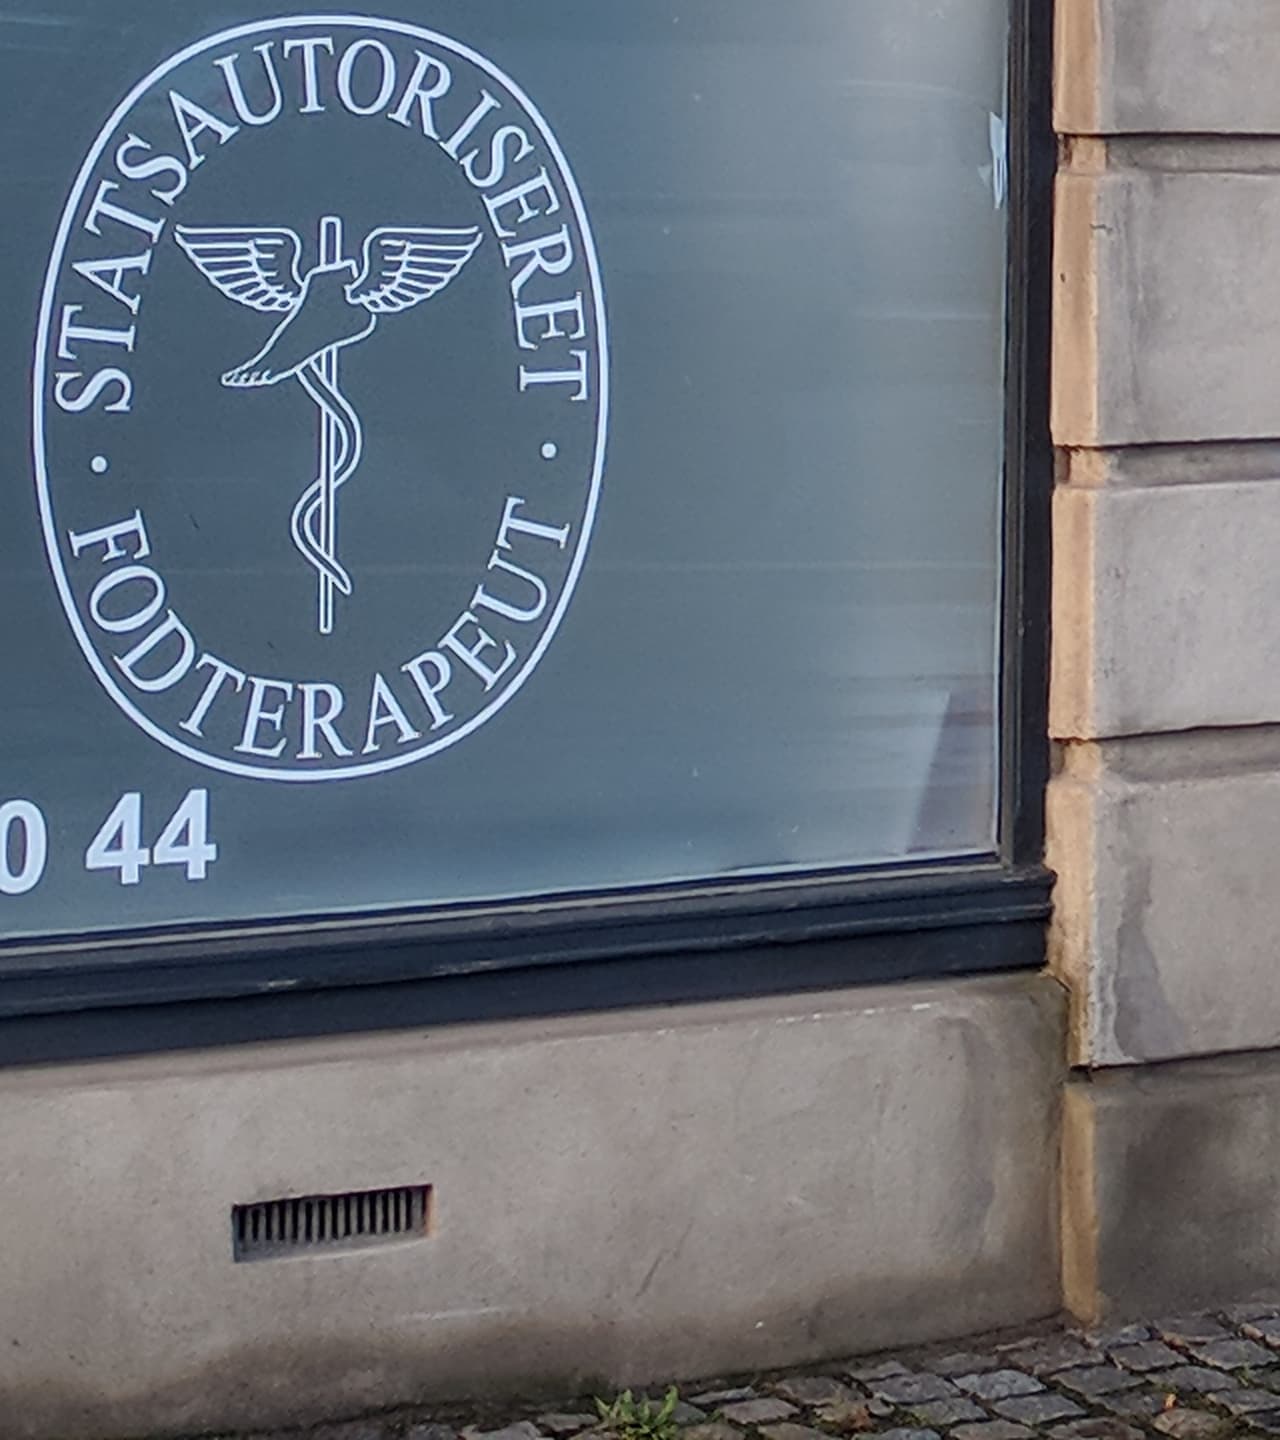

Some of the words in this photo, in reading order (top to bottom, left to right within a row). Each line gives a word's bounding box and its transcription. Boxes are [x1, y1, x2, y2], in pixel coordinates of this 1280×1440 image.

[55, 37, 589, 415] STATSAUTORISERET
[68, 496, 572, 760] FODTERAPEUT
[85, 787, 218, 886] 44
